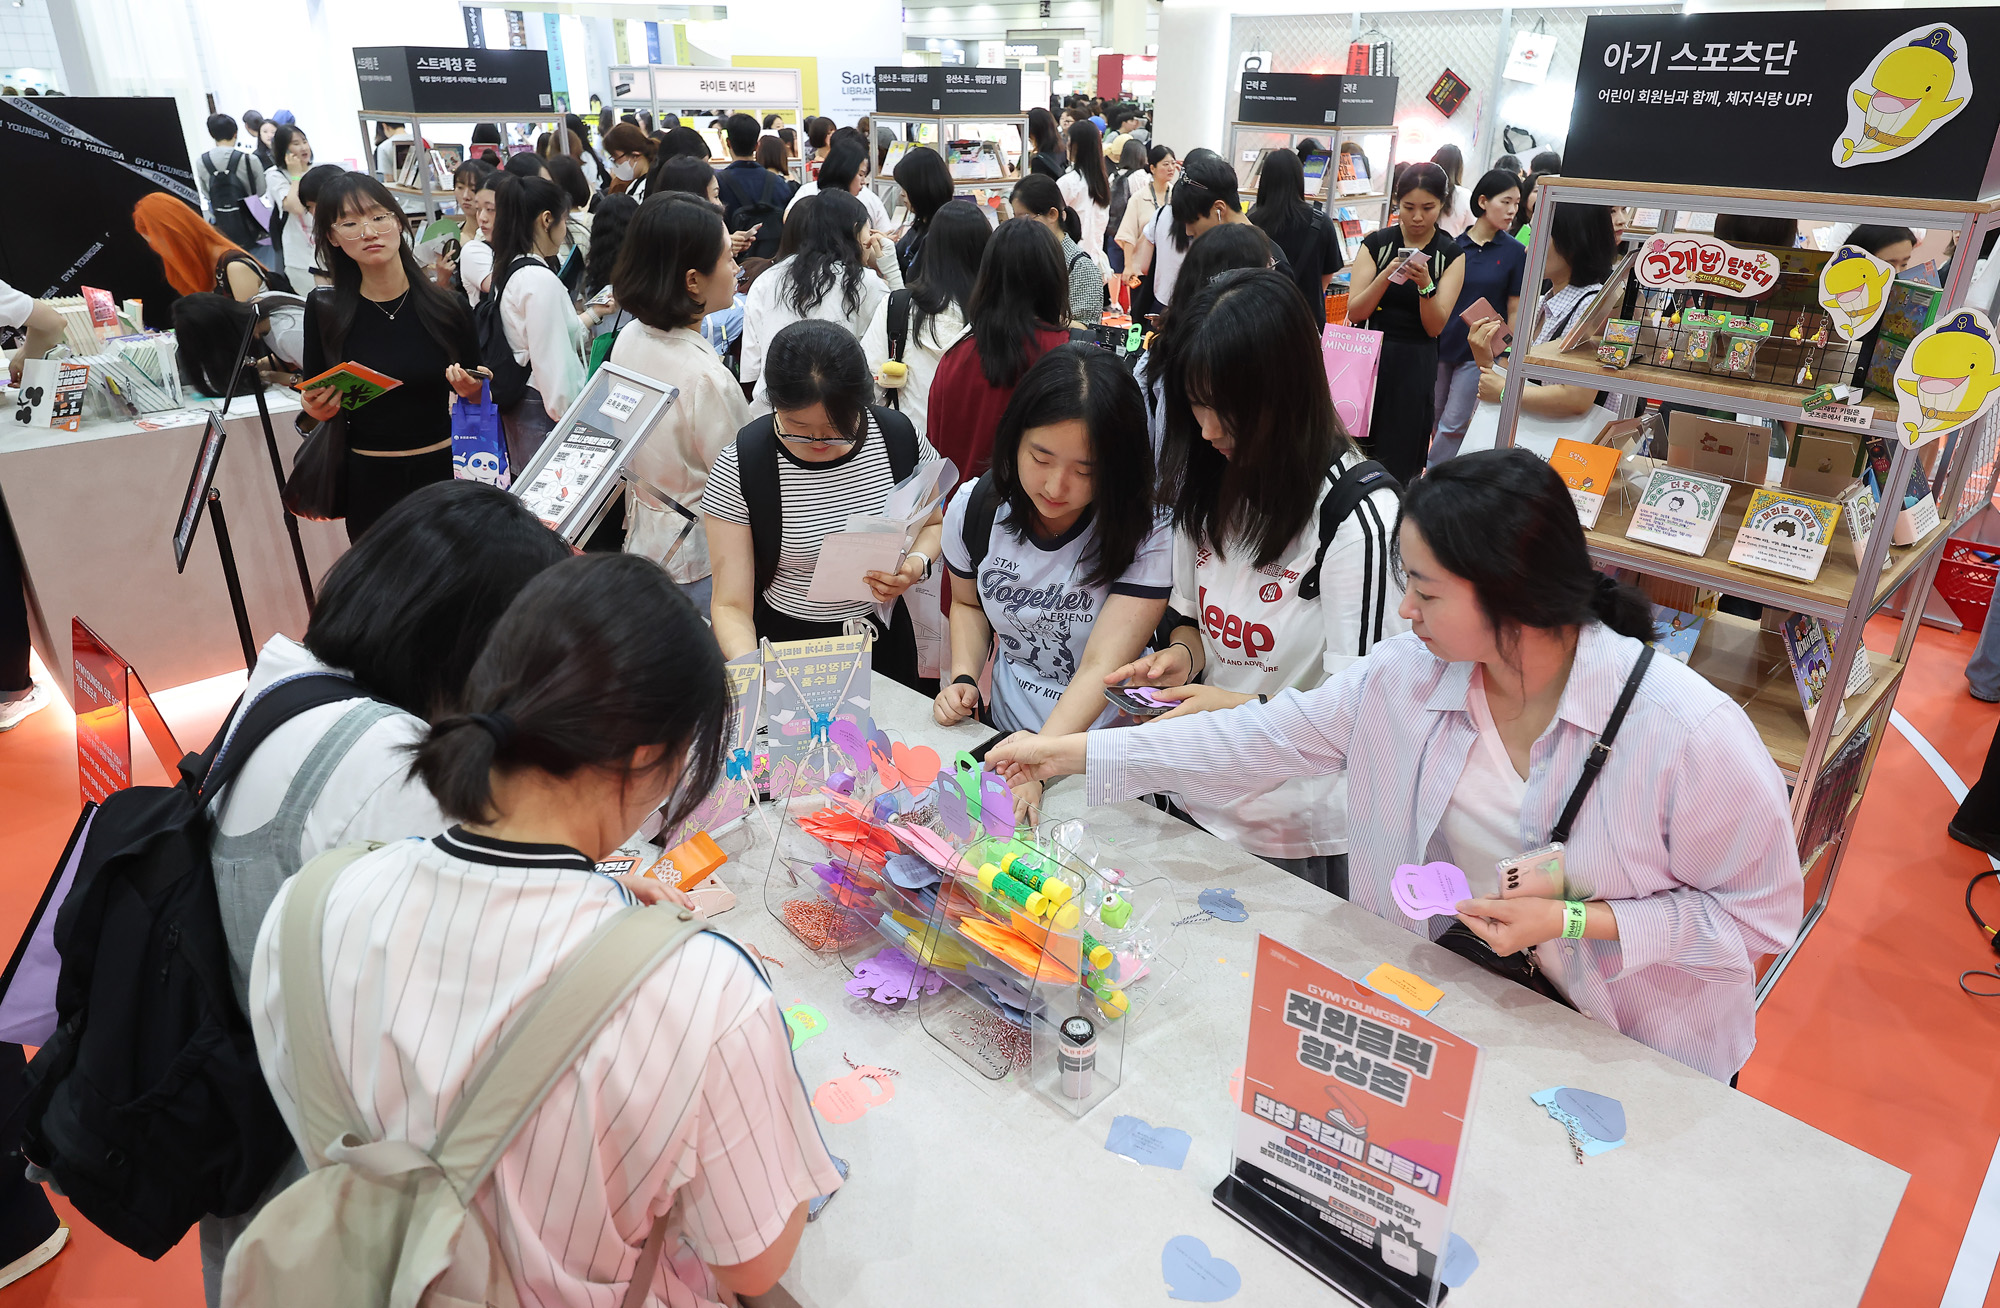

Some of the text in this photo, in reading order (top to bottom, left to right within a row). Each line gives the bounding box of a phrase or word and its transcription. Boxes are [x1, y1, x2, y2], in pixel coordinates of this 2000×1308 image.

[417, 57, 477, 72] 스트레칭 존
[1603, 40, 1798, 75] 아기 스포츠단
[841, 71, 877, 85] Salte
[878, 73, 892, 83] 유산소
[946, 75, 963, 84] 유산소
[964, 75, 970, 84] 존
[975, 75, 992, 85] 워밍업
[996, 76, 1008, 85] 워킹
[1245, 80, 1267, 91] 근력 존
[700, 80, 756, 92] 라이트 에디션
[841, 87, 876, 95] LIBRAR
[1598, 88, 1813, 108] 어린이 회원님과 함께, 체지식량 UP!
[13, 97, 76, 137] GYM YOUNGSA
[6, 121, 50, 140] YOUNGSA
[60, 136, 82, 149] GYM
[84, 142, 125, 161] YOUNGSA
[135, 157, 154, 170] GYM
[151, 172, 171, 187] GYM
[60, 241, 105, 283] GYM YOUNGSA
[1648, 247, 1773, 288] 고래밥 탐험대
[1329, 329, 1375, 344] since 1966
[1324, 340, 1373, 355] MINUMSA
[1808, 411, 1867, 426] 굿즈존에서 판매 중
[1839, 406, 1860, 416] 키링은
[1761, 505, 1816, 530] 머리는 이렇게
[993, 557, 1020, 572] STAY
[981, 567, 1095, 613] Together
[1050, 612, 1094, 623] FRIEND
[1199, 585, 1276, 658] Jeep
[1226, 659, 1243, 667] AND
[1015, 677, 1064, 701] UFFY KITT
[1307, 983, 1412, 1029] GYMYOUNGSA
[1254, 1091, 1297, 1131] 펀칭
[1298, 1111, 1366, 1162] 책갈피
[1366, 1142, 1442, 1197] 만들기
